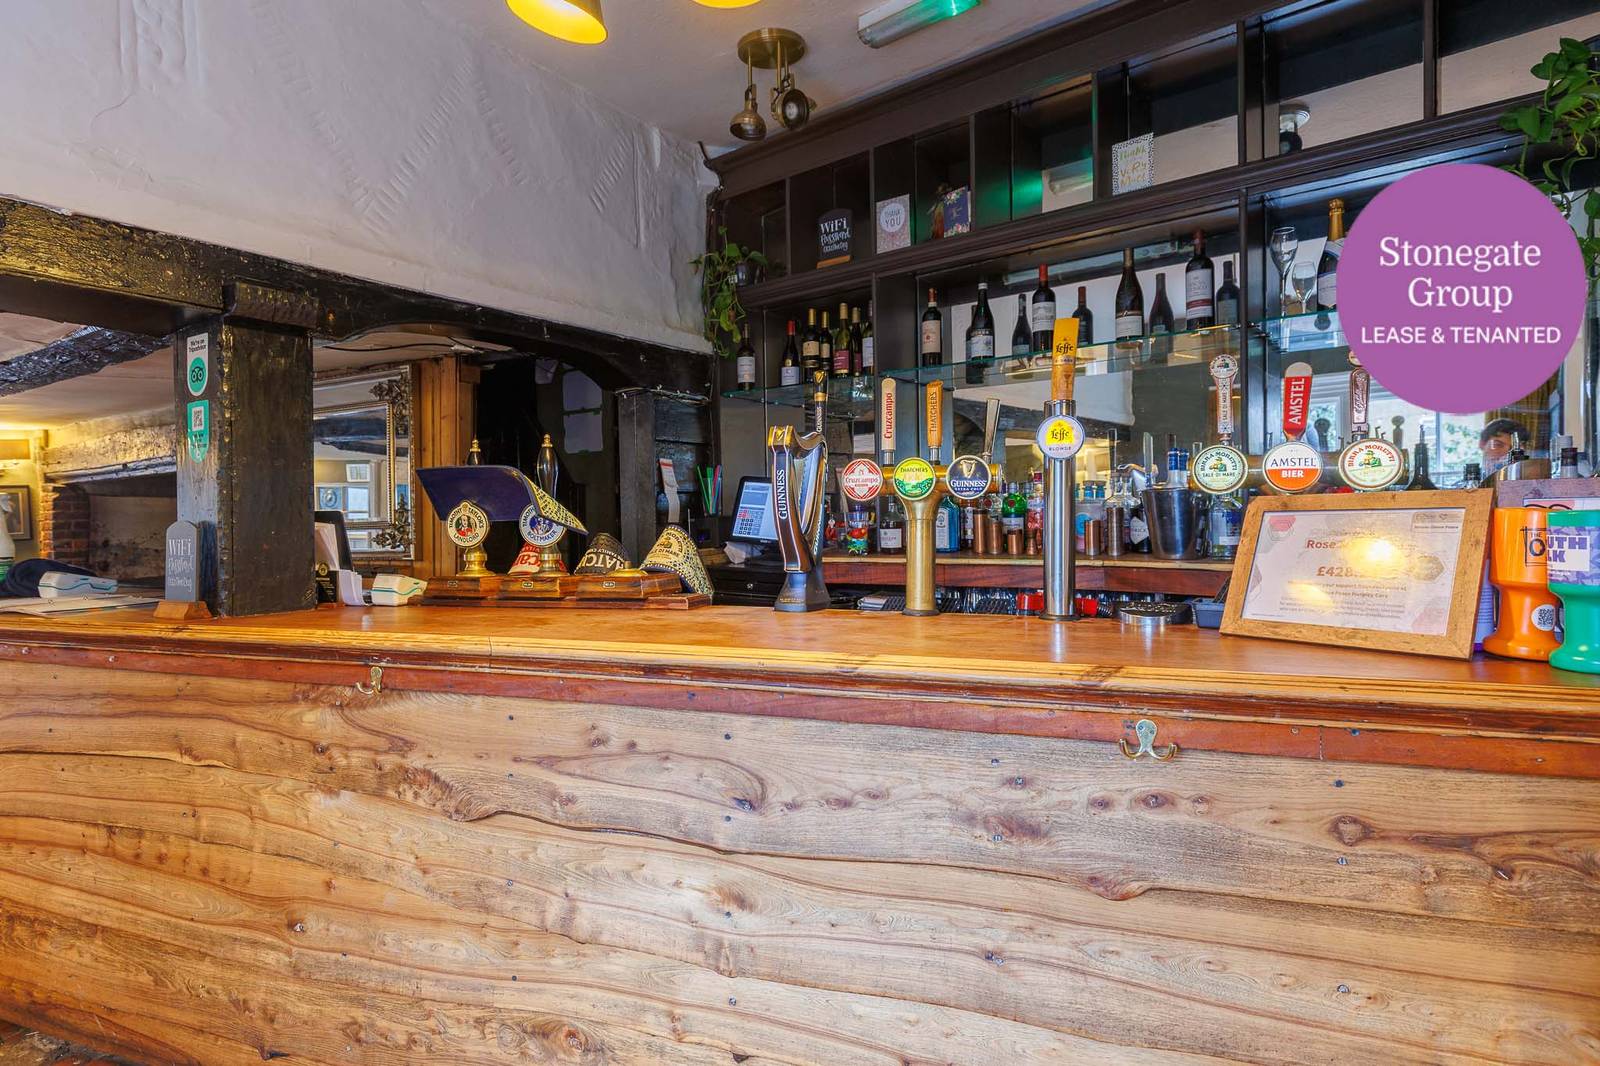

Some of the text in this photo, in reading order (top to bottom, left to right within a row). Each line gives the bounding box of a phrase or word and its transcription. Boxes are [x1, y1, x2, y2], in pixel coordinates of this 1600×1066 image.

[885, 214, 901, 227] YOU
[1055, 342, 1075, 355] Leffe
[1288, 377, 1306, 425] AMSTEL
[884, 392, 895, 439] Cruzcampo
[929, 391, 938, 434] THATCHERS
[1050, 427, 1070, 442] Leffe
[1215, 451, 1238, 471] MORETTI
[1270, 457, 1316, 468] AMSTEL
[1347, 444, 1396, 468] BIRRA MORETTI
[900, 466, 929, 474] THATCHERS
[1281, 469, 1304, 478] BIER
[845, 476, 879, 484] Cruzcampo
[950, 479, 988, 488] GUINNESS
[776, 469, 787, 520] GUINNESS
[522, 505, 535, 527] TIMOTH
[168, 538, 192, 556] WiFi
[1306, 538, 1336, 550] Rose
